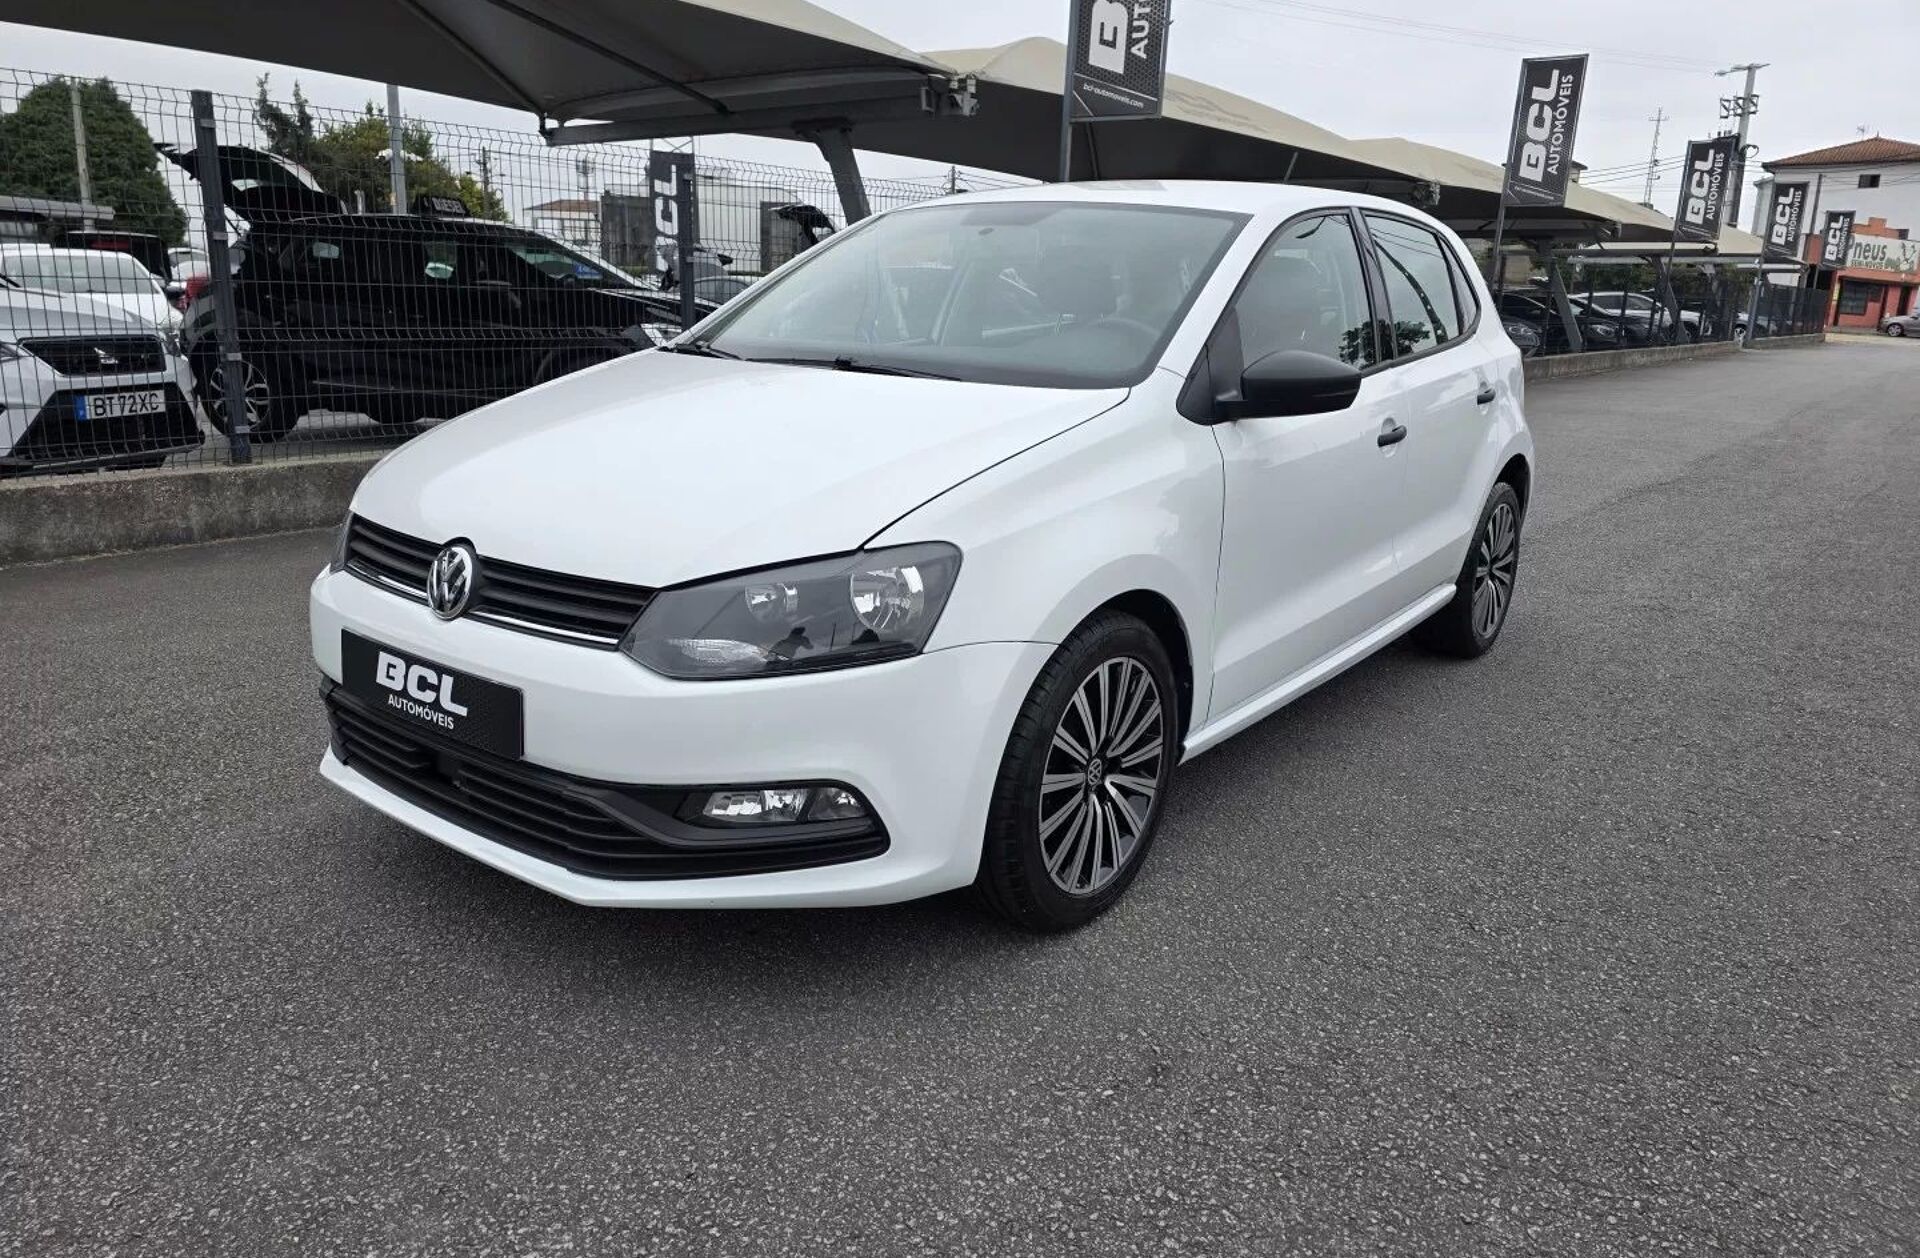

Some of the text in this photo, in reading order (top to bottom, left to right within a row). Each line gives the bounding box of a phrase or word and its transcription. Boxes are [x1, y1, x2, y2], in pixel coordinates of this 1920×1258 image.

[1131, 0, 1153, 59] AUT
[1519, 69, 1560, 182] BCL
[1547, 74, 1574, 174] AUTOMÓVEIS
[1685, 149, 1715, 225] BCL
[1706, 153, 1725, 220] AUTOMÓVEIS
[1771, 187, 1795, 246] BCL
[1825, 215, 1844, 261] BCL
[375, 651, 468, 717] BCL
[387, 694, 455, 730] AUTOMÓVEIS
